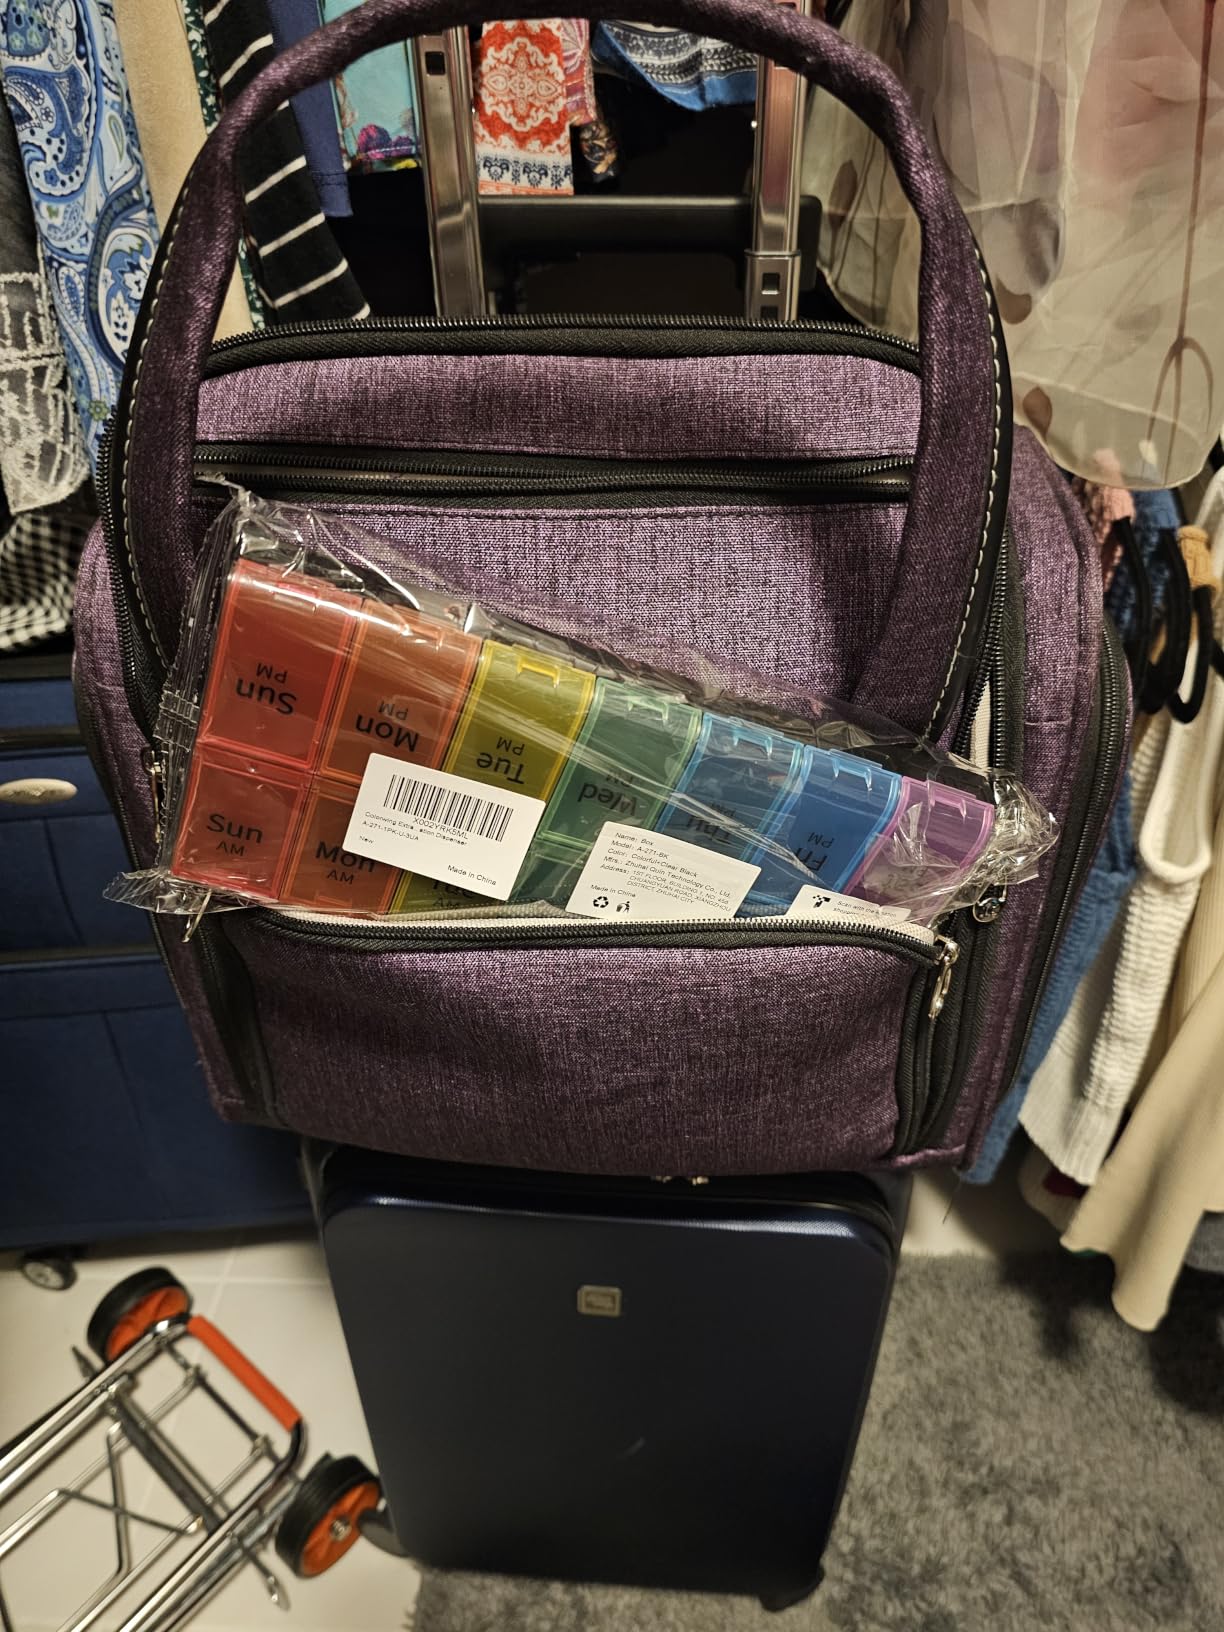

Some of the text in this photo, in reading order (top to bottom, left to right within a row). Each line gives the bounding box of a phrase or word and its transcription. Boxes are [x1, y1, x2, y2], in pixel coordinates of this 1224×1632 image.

[256, 662, 288, 684] PM
[237, 679, 297, 716] Sun
[378, 700, 409, 721] PM
[355, 714, 420, 752] Mon
[495, 736, 525, 756] PM
[476, 752, 526, 785] Tue
[577, 782, 638, 817] Wed
[206, 813, 264, 844] Sun
[615, 832, 654, 846] Name: Box
[215, 841, 246, 857] AM
[807, 831, 835, 849] PM
[315, 841, 376, 873] Mon
[327, 868, 355, 884] AM
[446, 864, 498, 887] Made in China
[667, 871, 703, 889] Technology
[617, 889, 636, 898] China
